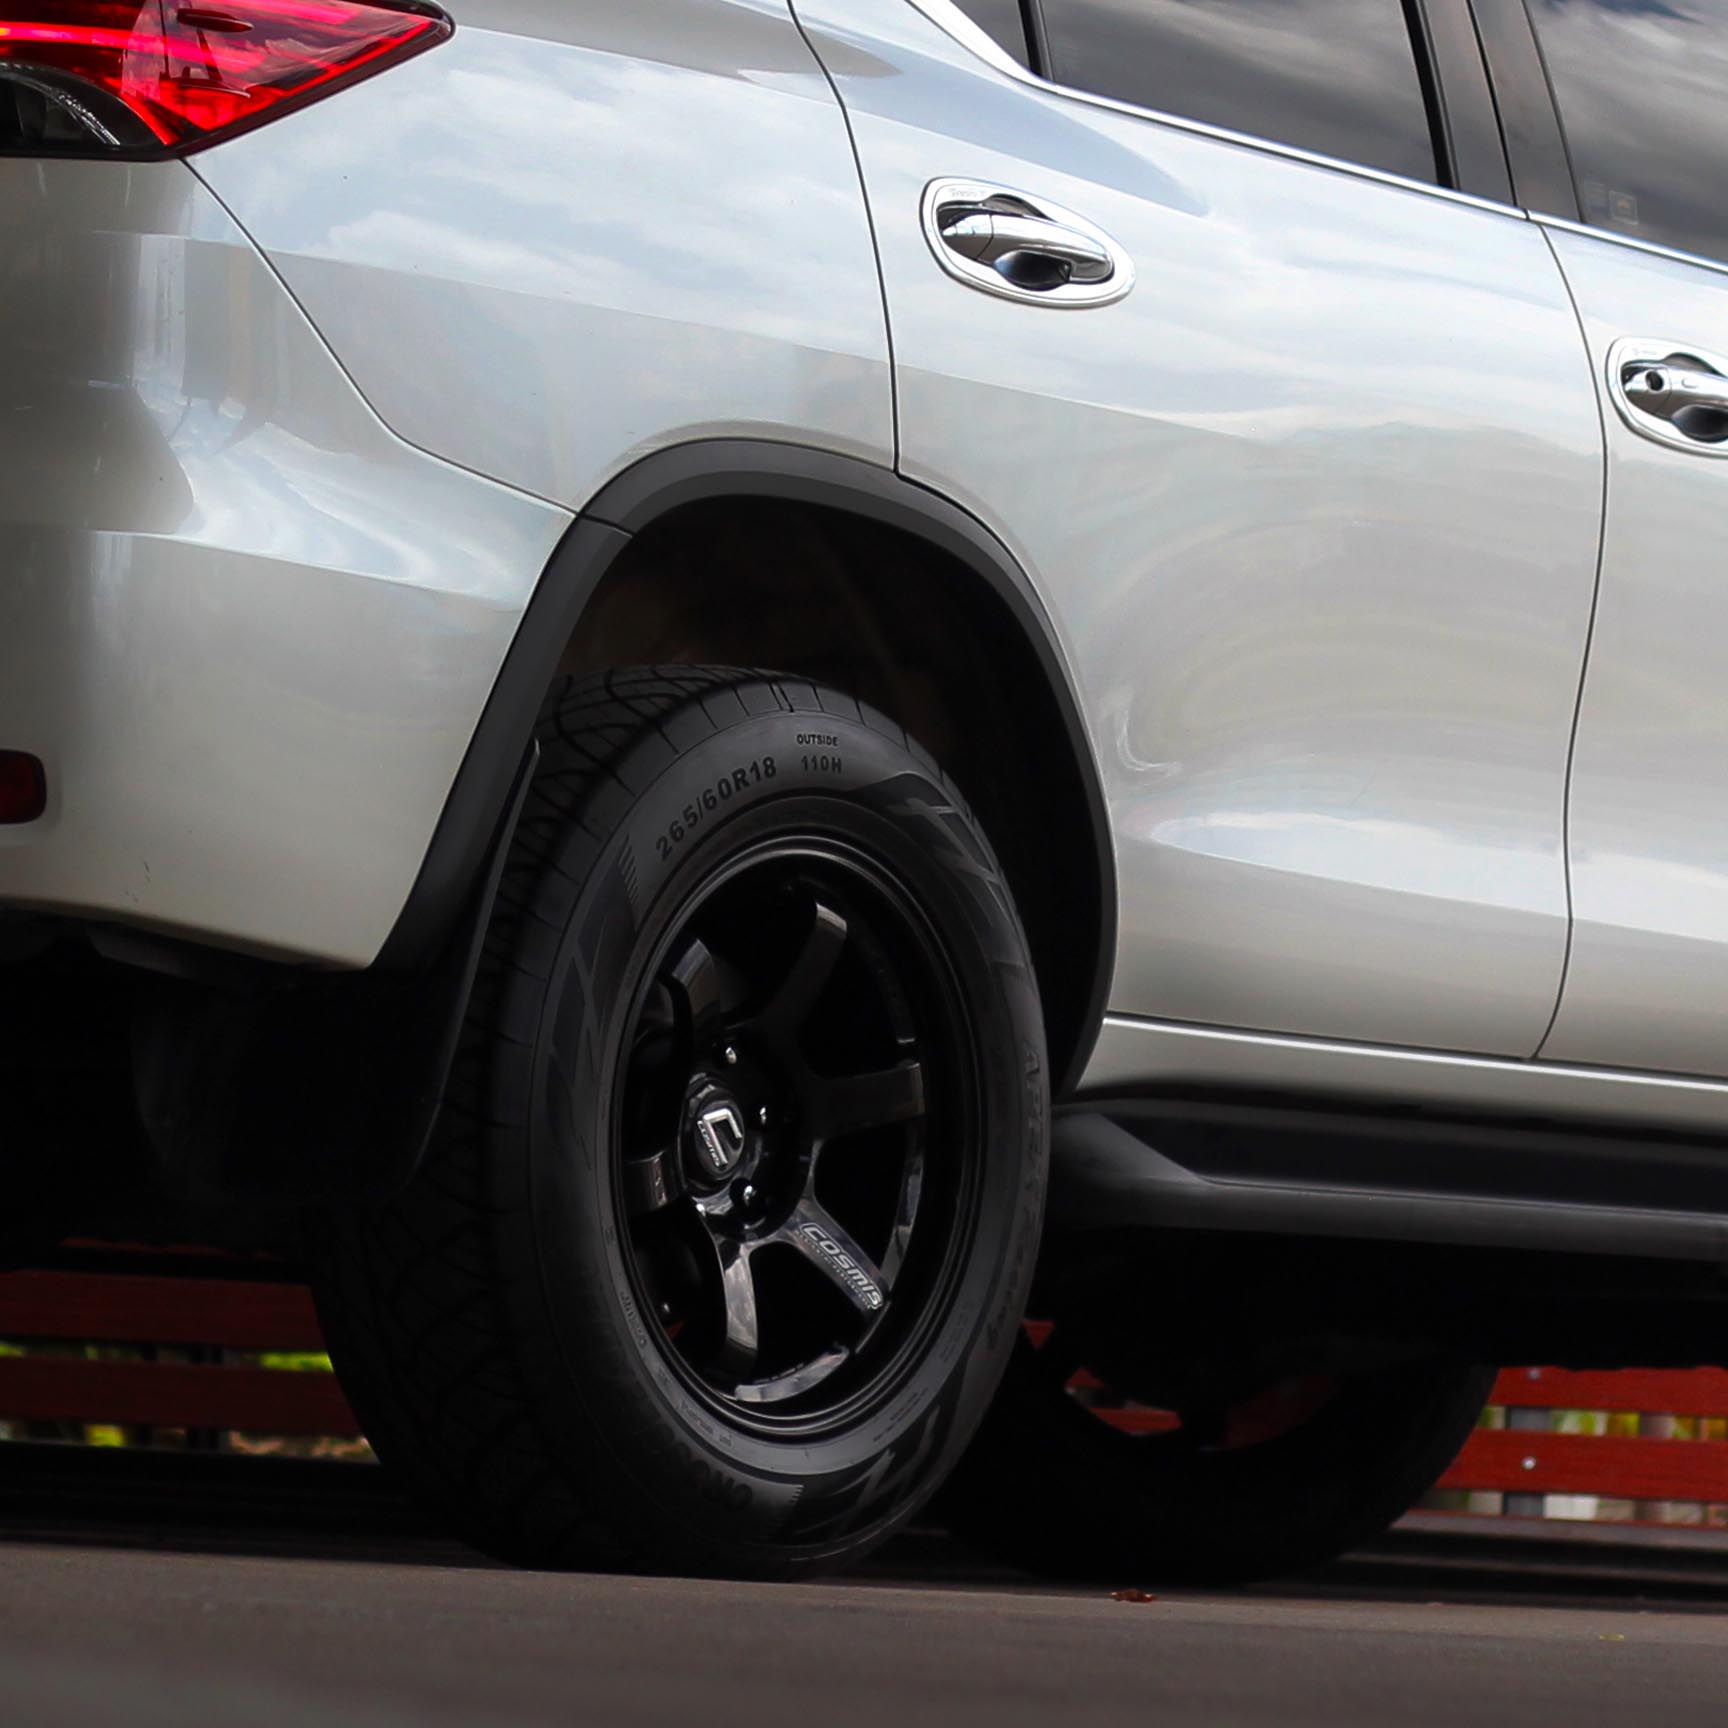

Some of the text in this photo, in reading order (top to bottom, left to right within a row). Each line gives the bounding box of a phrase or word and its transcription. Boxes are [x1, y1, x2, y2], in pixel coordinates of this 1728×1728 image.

[795, 731, 840, 748] OUTSIDE
[654, 754, 843, 862] 265/60R18 110H
[801, 1223, 885, 1309] COSMIS
